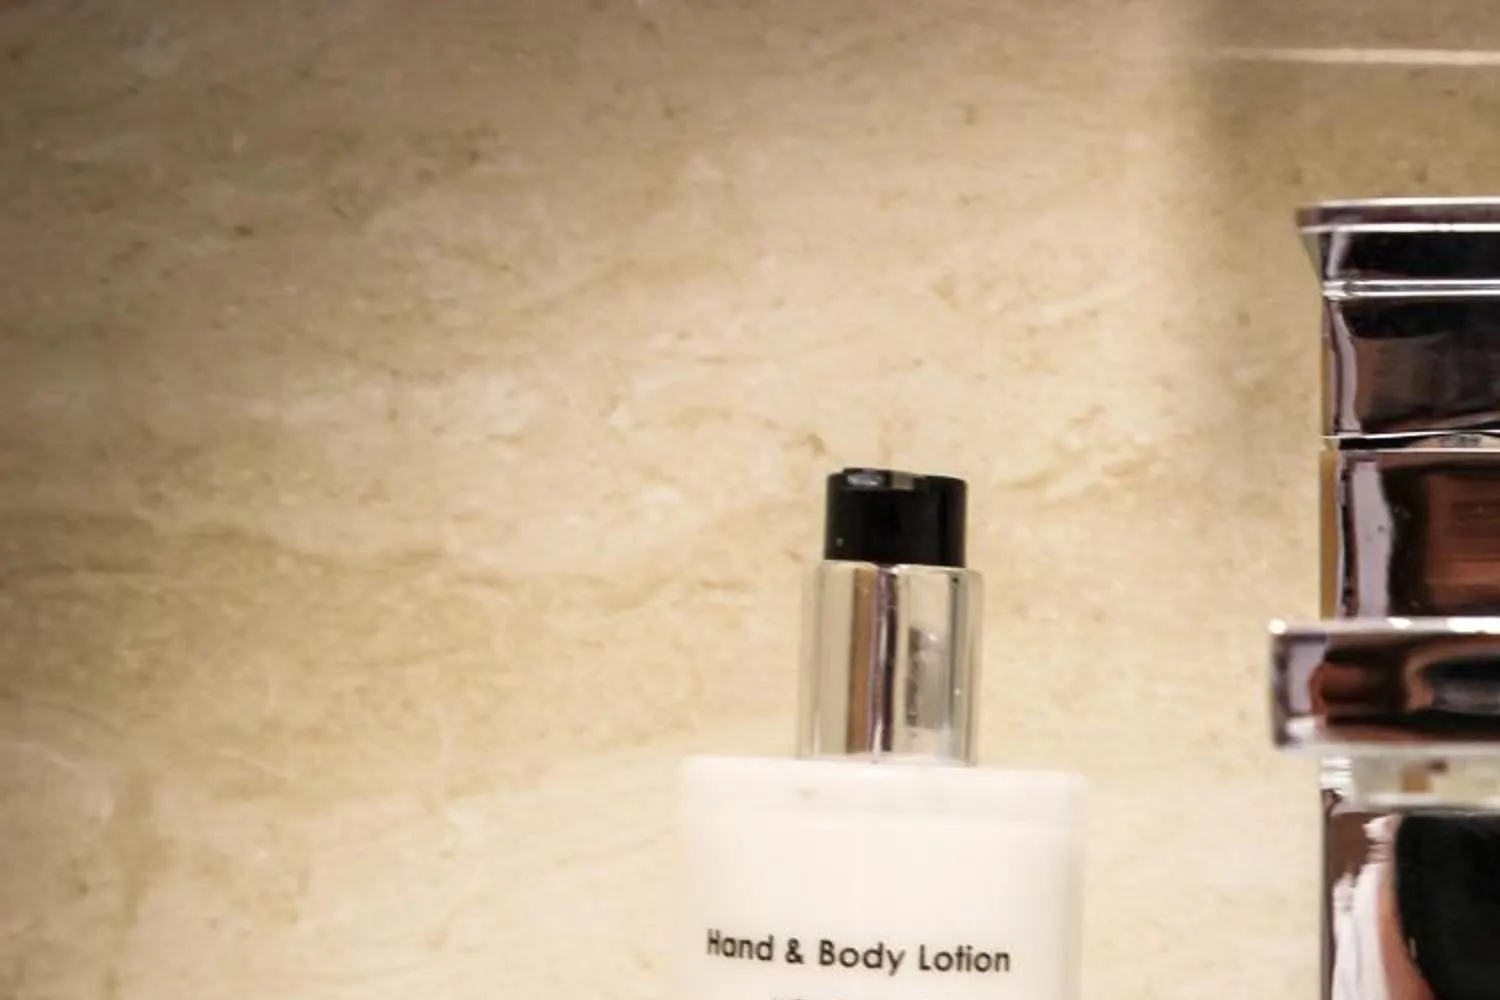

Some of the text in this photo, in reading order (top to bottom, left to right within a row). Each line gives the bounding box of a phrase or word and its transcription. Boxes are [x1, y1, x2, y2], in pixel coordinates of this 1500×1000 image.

[706, 928, 1011, 977] Hand & Body Lotion
